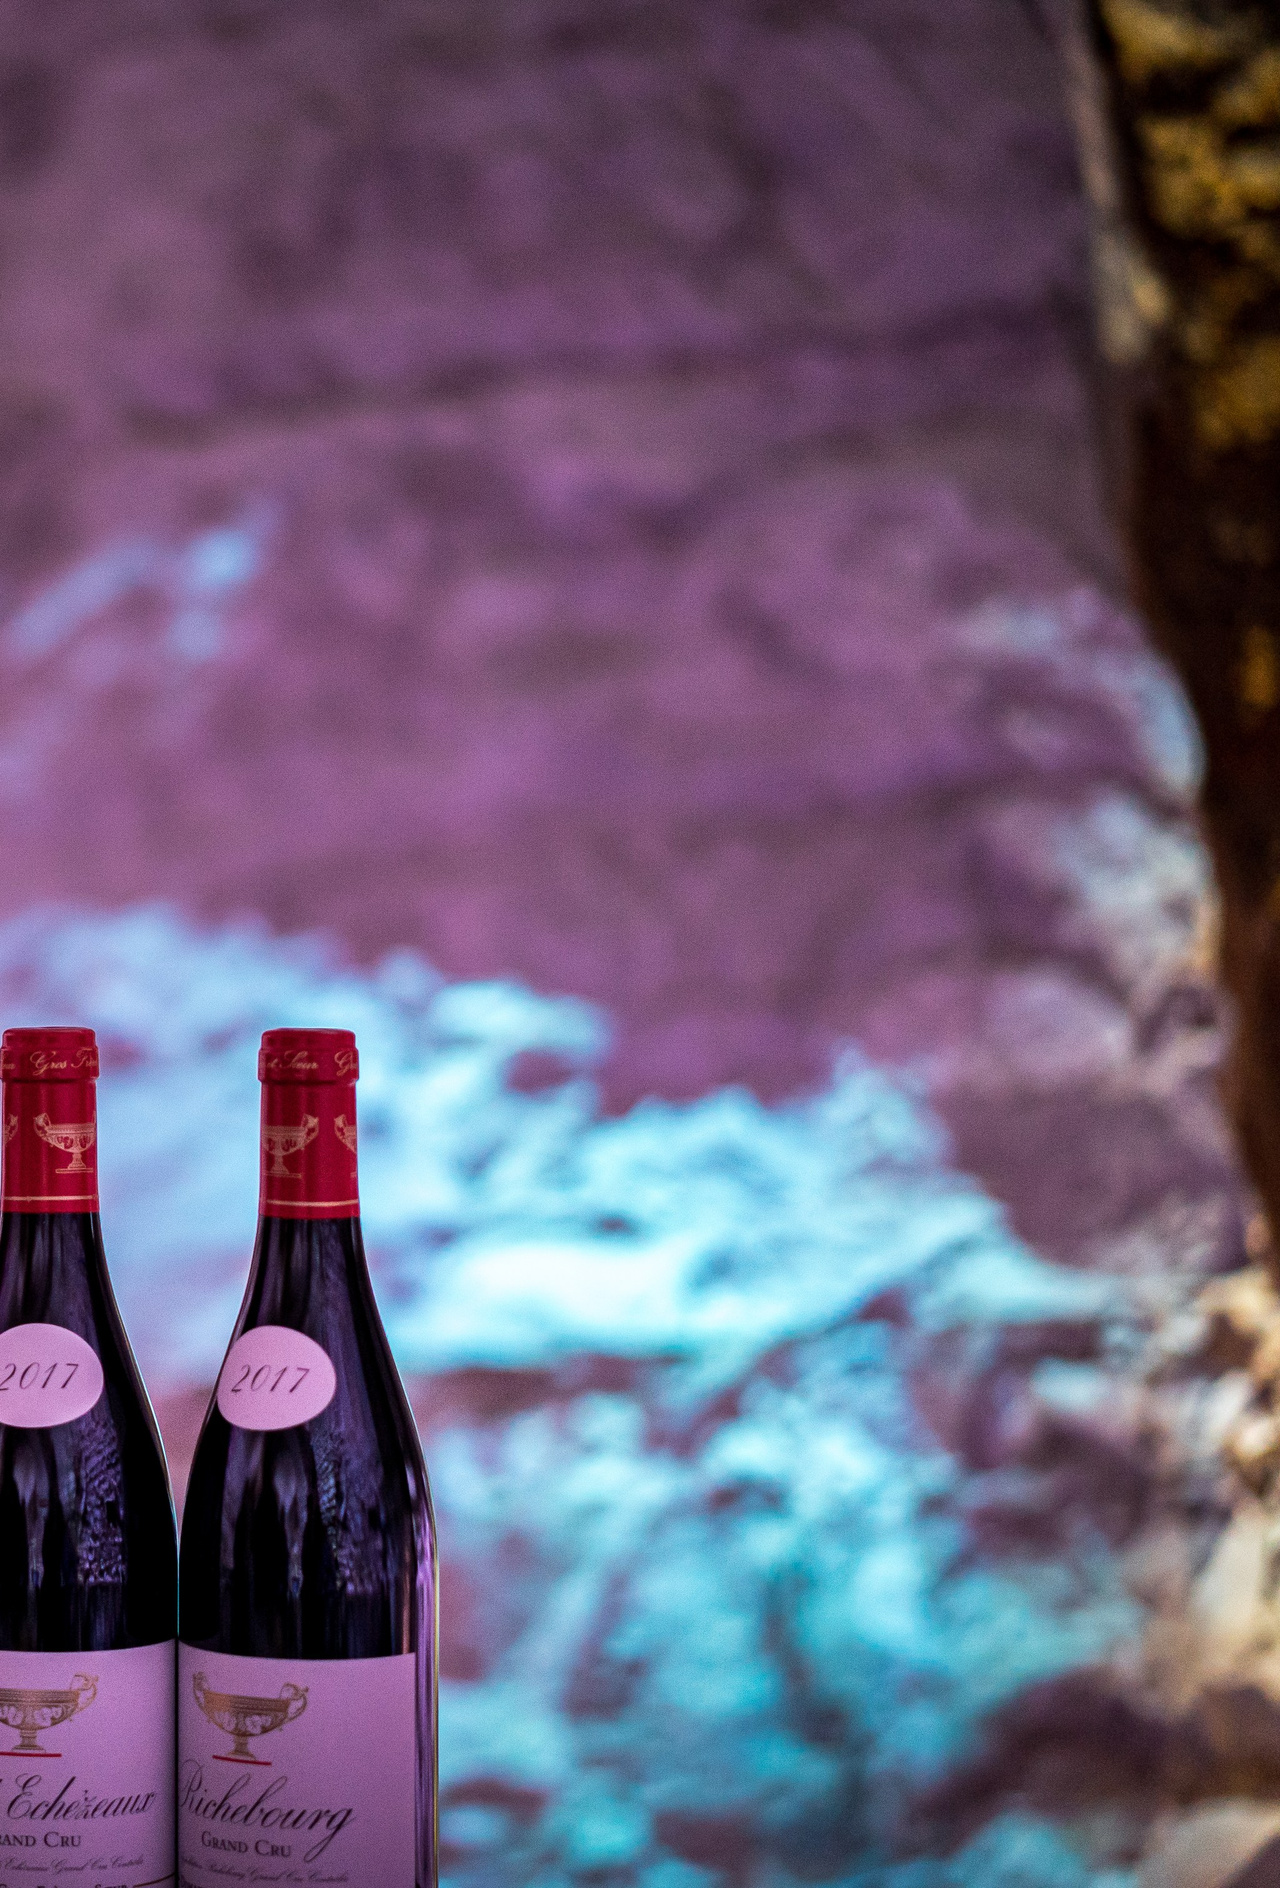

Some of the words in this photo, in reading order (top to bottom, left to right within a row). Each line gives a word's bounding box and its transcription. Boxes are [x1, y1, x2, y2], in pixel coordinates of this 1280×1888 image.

[30, 1051, 67, 1076] Gros
[231, 1364, 310, 1393] 2017
[179, 1759, 357, 1863] Richebourg
[43, 1831, 81, 1847] CRU
[201, 1830, 248, 1853] GRAND
[254, 1839, 292, 1858] CRU
